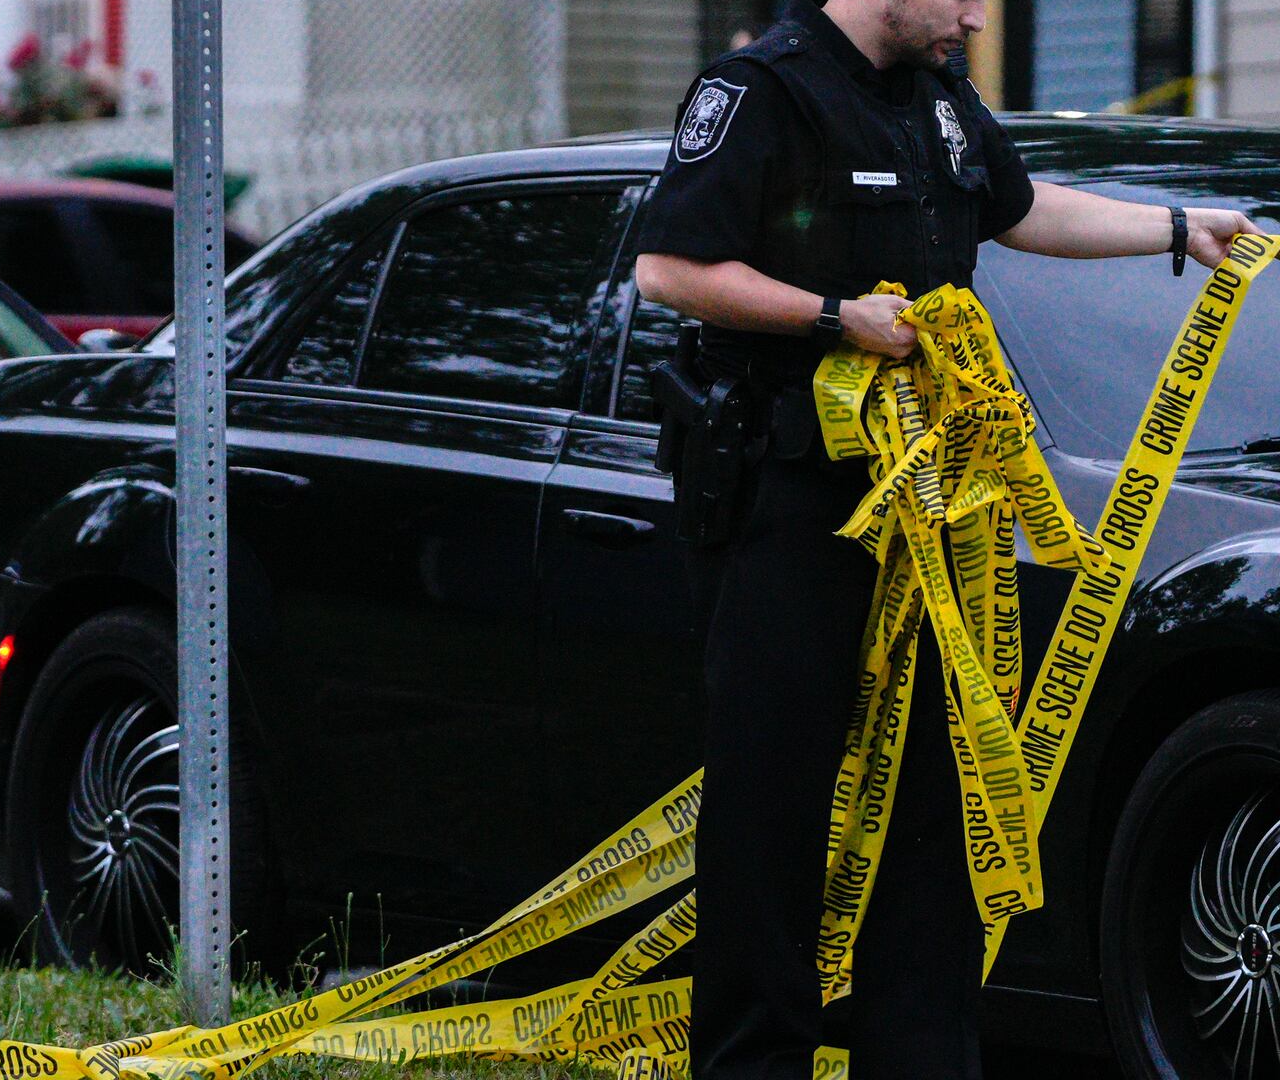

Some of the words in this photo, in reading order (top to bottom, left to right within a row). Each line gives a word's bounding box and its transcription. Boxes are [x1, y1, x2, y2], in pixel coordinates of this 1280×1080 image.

[1205, 267, 1242, 305] DO
[1171, 301, 1228, 381] SCENE
[1140, 378, 1196, 456] CRIME
[994, 508, 1016, 557] NOT
[1101, 467, 1159, 551] CROSS
[994, 567, 1018, 598] DO
[993, 604, 1019, 677] SCENE
[1064, 604, 1107, 644] DO
[1036, 639, 1095, 721] SCENE
[952, 735, 979, 782] NOT
[965, 792, 1006, 874] CROSS
[823, 850, 872, 924] CRIME
[634, 927, 677, 962] DO
